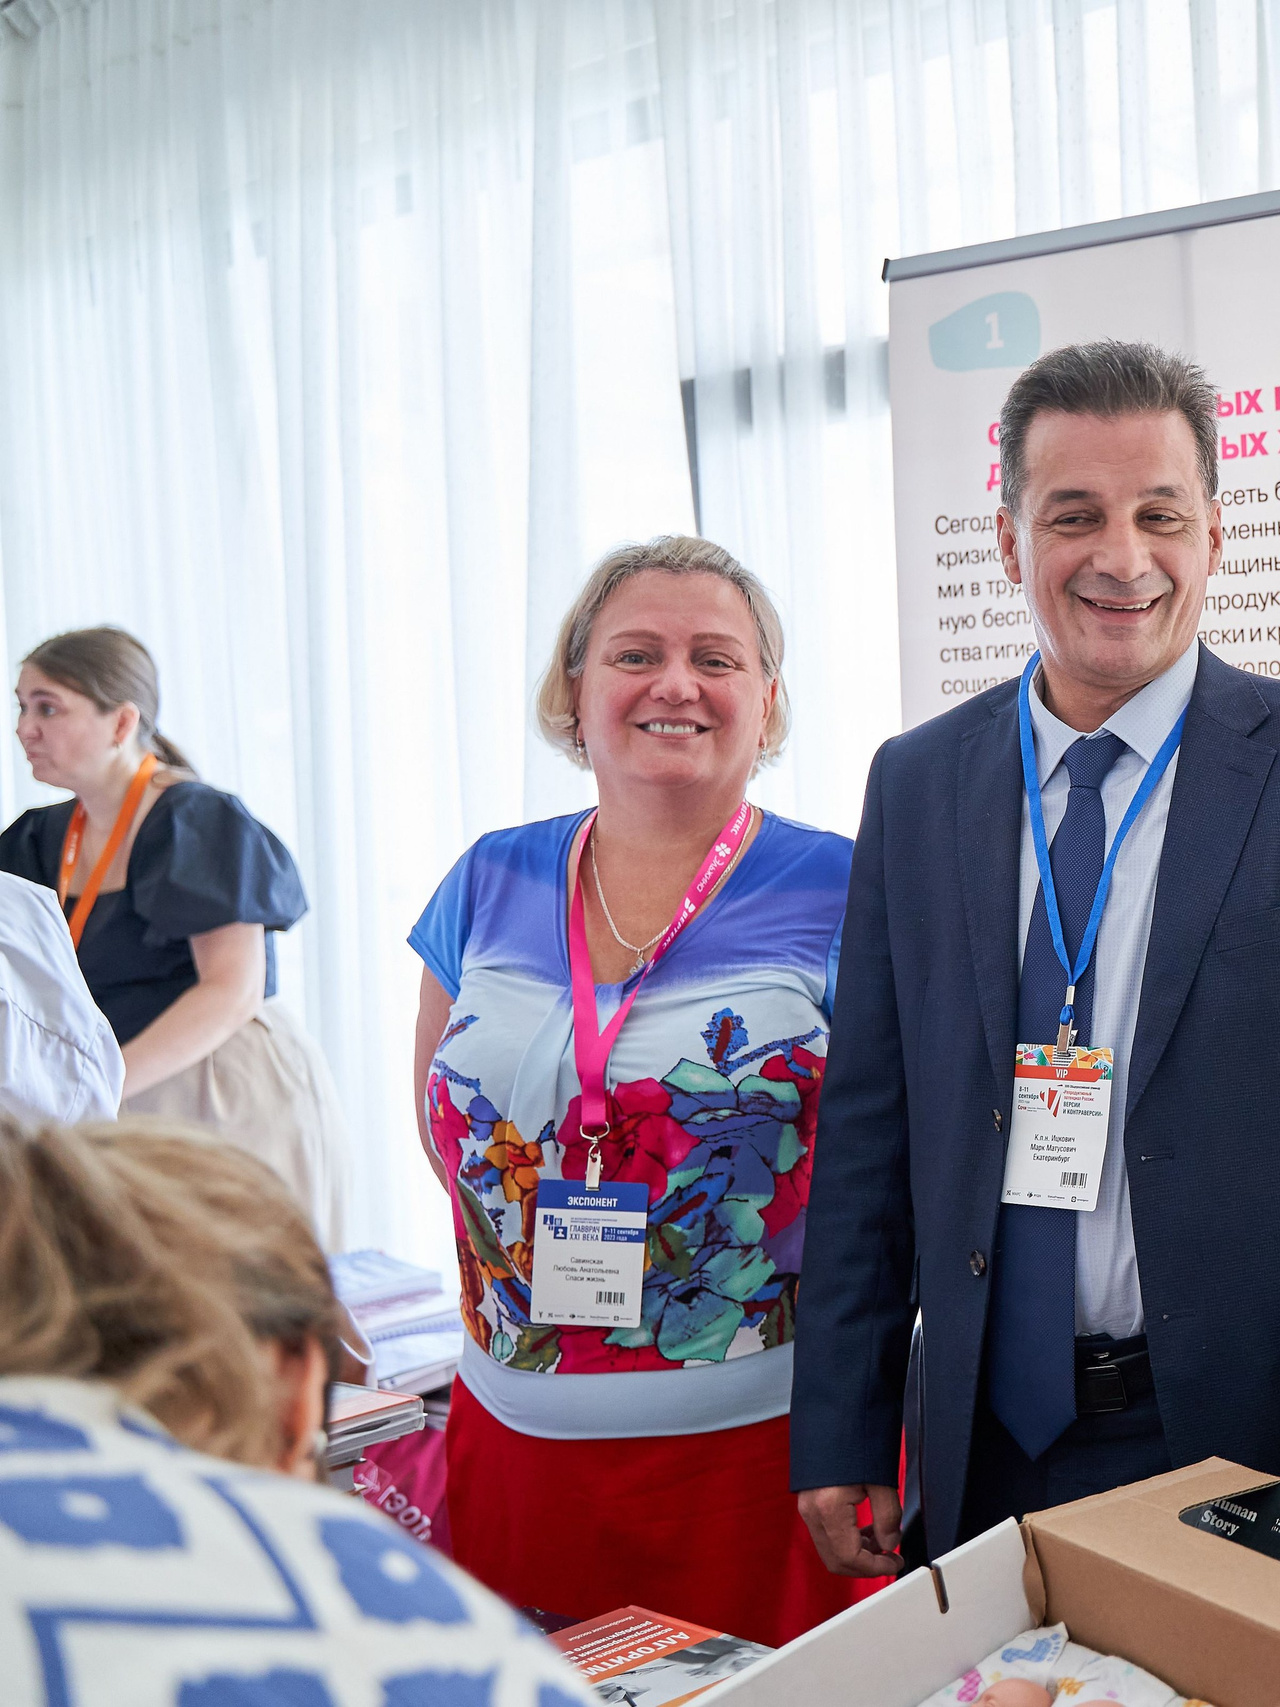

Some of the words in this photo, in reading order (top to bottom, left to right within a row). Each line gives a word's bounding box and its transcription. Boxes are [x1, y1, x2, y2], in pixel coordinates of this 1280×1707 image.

[985, 312, 1005, 350] 1
[1221, 482, 1268, 506] сеть
[935, 515, 997, 535] Сегод
[938, 583, 965, 599] ми
[971, 582, 981, 597] в
[939, 613, 977, 634] ную
[1249, 627, 1262, 643] и
[940, 645, 982, 663] ства
[662, 911, 689, 950] ВЕРТЕКС
[1055, 1068, 1068, 1079] VIP
[1030, 1143, 1046, 1152] Марк
[1046, 1144, 1077, 1154] Матусович
[1032, 1153, 1070, 1163] Екатеринбург
[567, 1196, 618, 1208] ЭКСПОНЕНТ
[569, 1225, 600, 1233] ГЛАВВРАЧ
[582, 1233, 599, 1241] ВЕКА
[553, 1265, 578, 1273] Любовь
[579, 1266, 620, 1275] Анатольевна
[1200, 1509, 1240, 1537] Story
